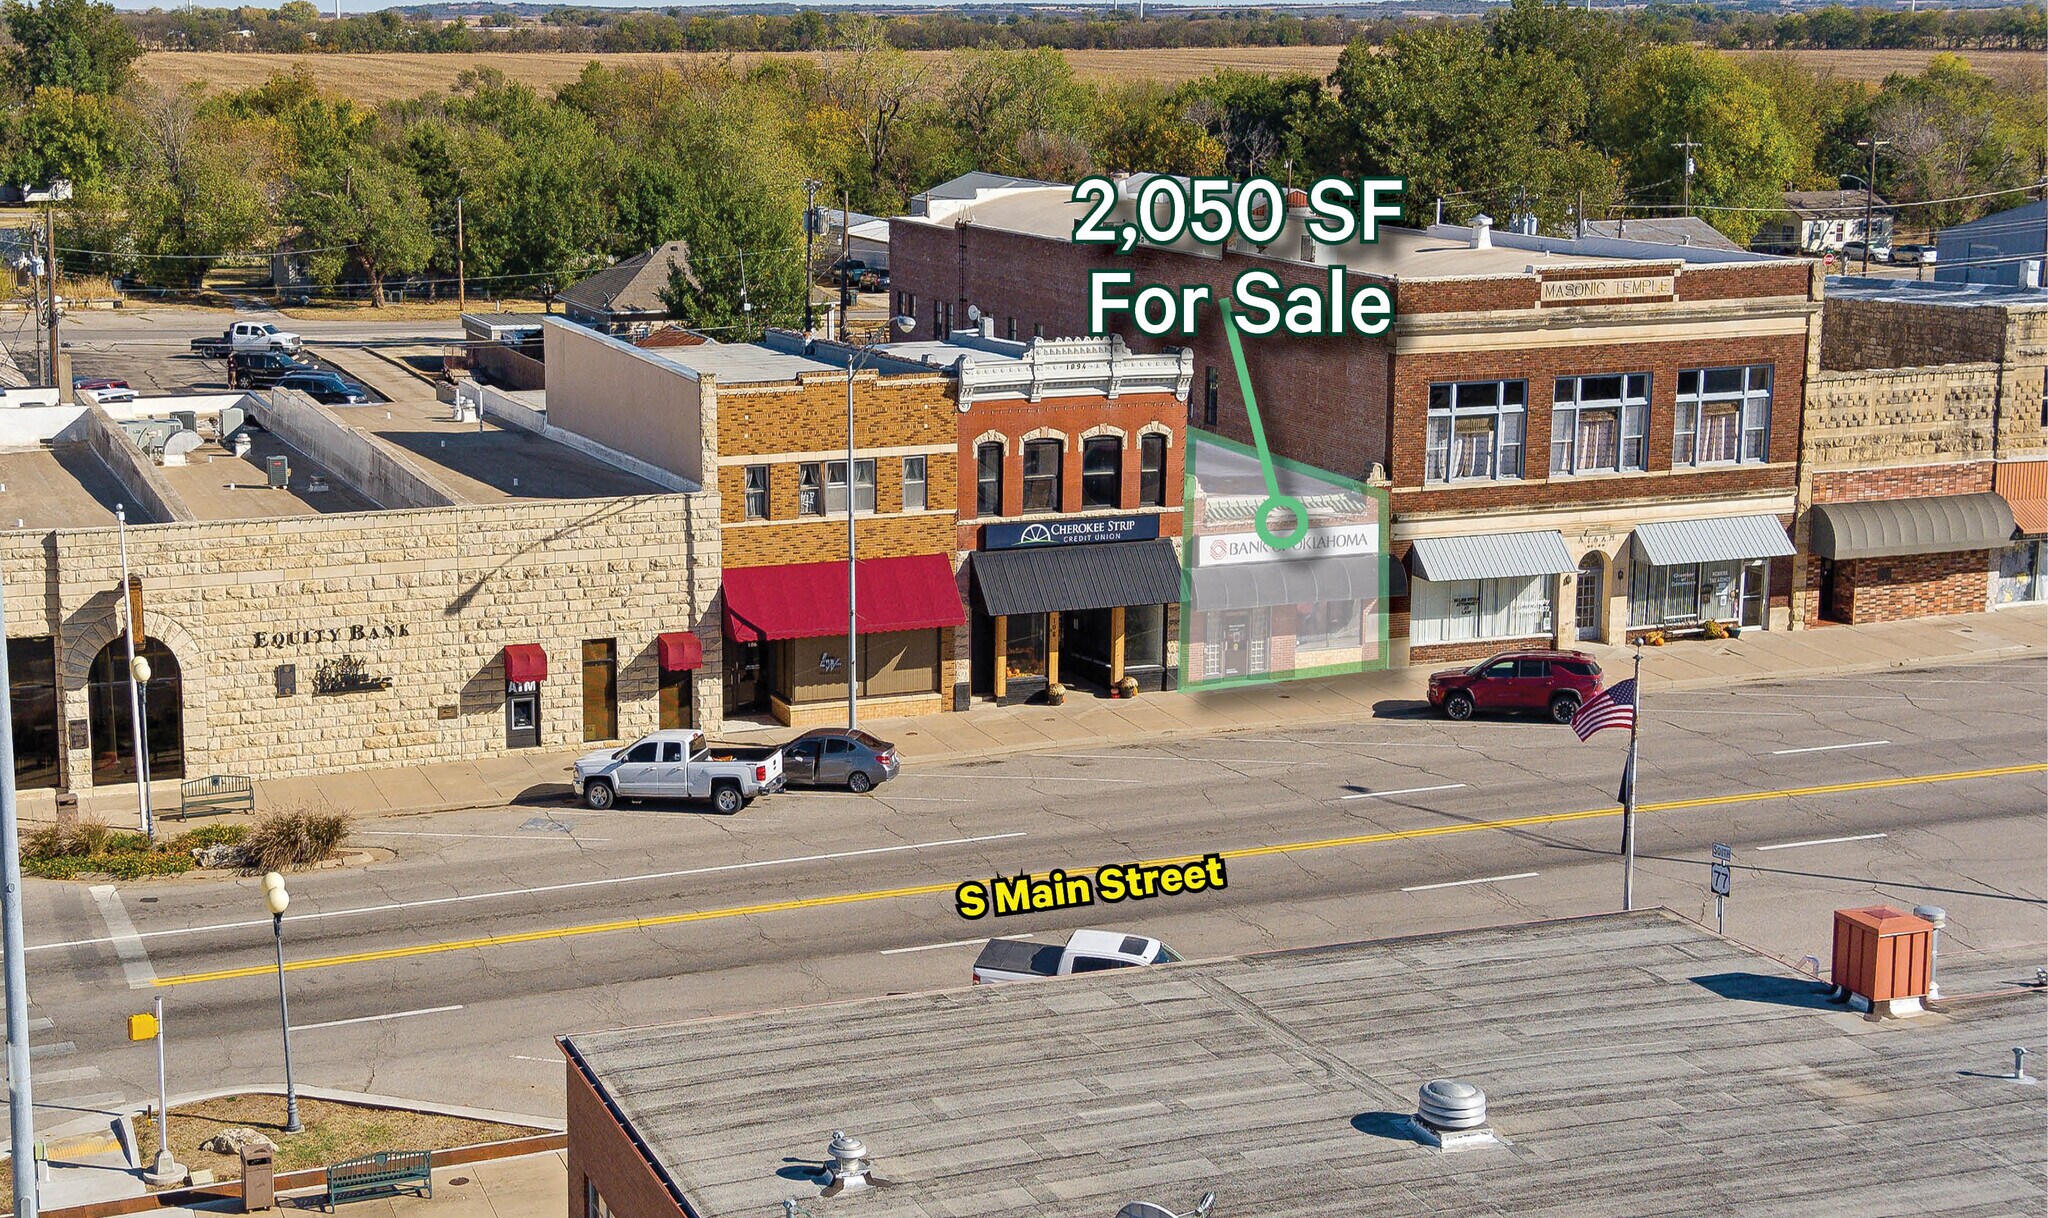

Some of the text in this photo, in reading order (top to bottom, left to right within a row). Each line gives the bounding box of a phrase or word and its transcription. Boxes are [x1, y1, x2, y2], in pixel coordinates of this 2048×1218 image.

[1544, 278, 1671, 299] MASONIC TEMPLE
[1051, 520, 1136, 536] CHEROKEE STRIP
[1063, 532, 1121, 543] CREDIT UNION
[1229, 540, 1268, 555] BANK
[252, 623, 410, 649] EQUITY BANK
[1714, 870, 1728, 889] 77
